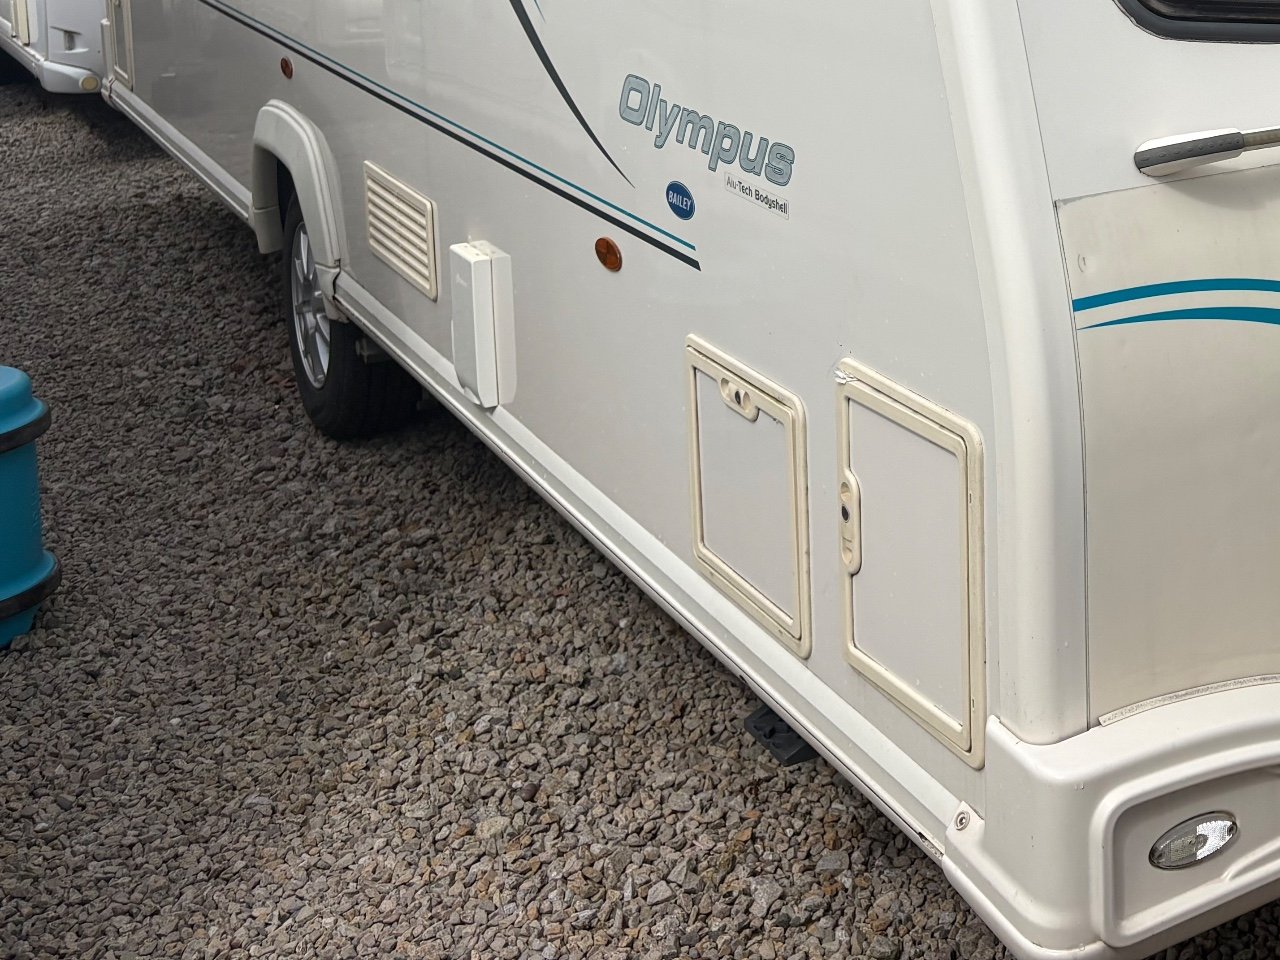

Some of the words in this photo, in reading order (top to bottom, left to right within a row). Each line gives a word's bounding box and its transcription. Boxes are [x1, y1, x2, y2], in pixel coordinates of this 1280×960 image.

[619, 74, 796, 187] Olympus
[668, 190, 692, 211] BAILEY
[726, 176, 753, 198] Alu-Tech
[755, 189, 788, 215] Bodyshell
